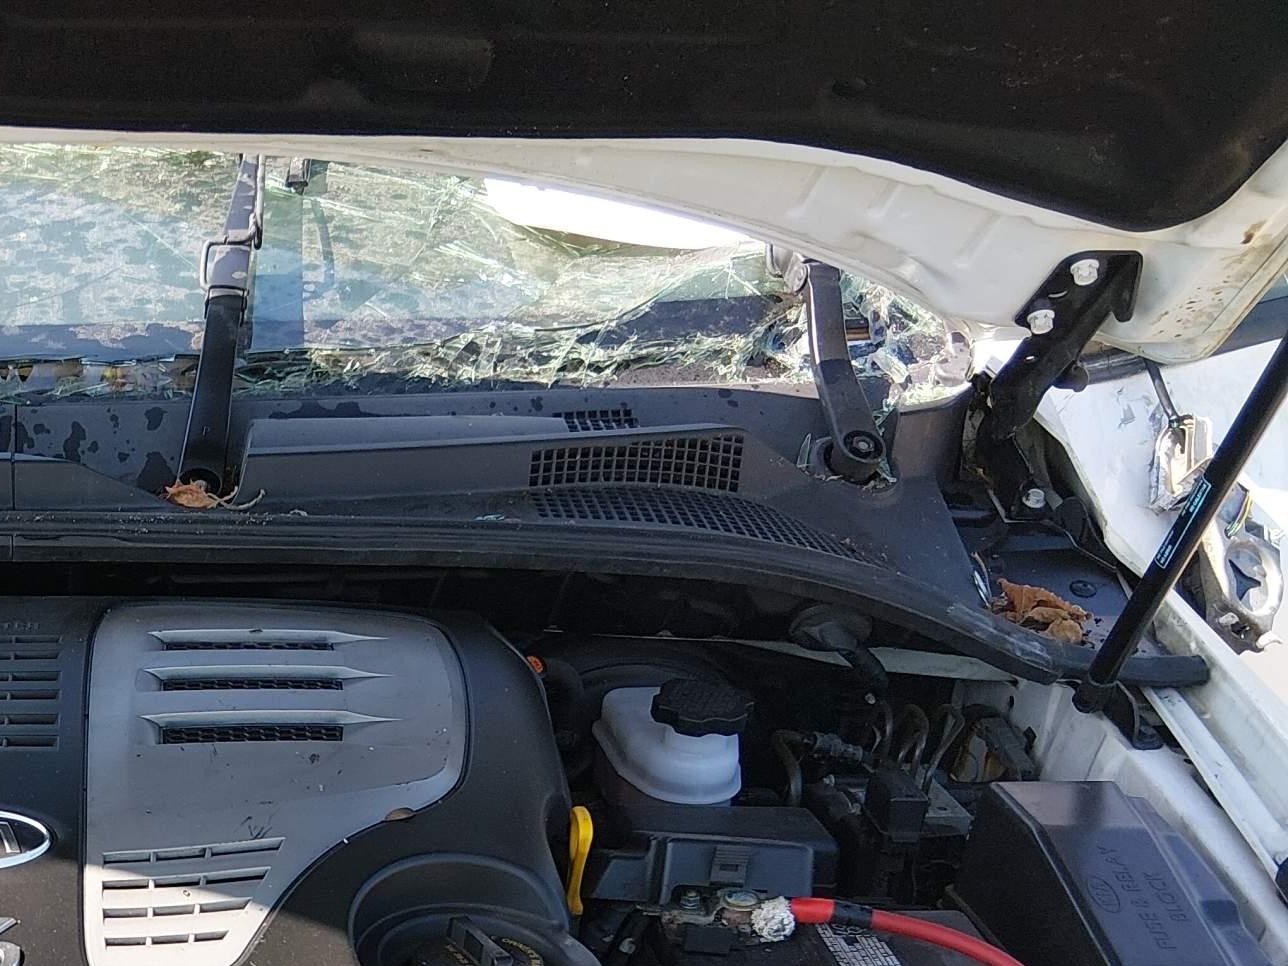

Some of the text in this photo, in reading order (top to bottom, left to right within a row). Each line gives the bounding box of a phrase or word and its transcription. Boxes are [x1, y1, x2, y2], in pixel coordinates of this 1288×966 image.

[1096, 845, 1143, 893] RELAY
[1142, 871, 1190, 921] BLOCK
[1137, 912, 1177, 951] FUSE
